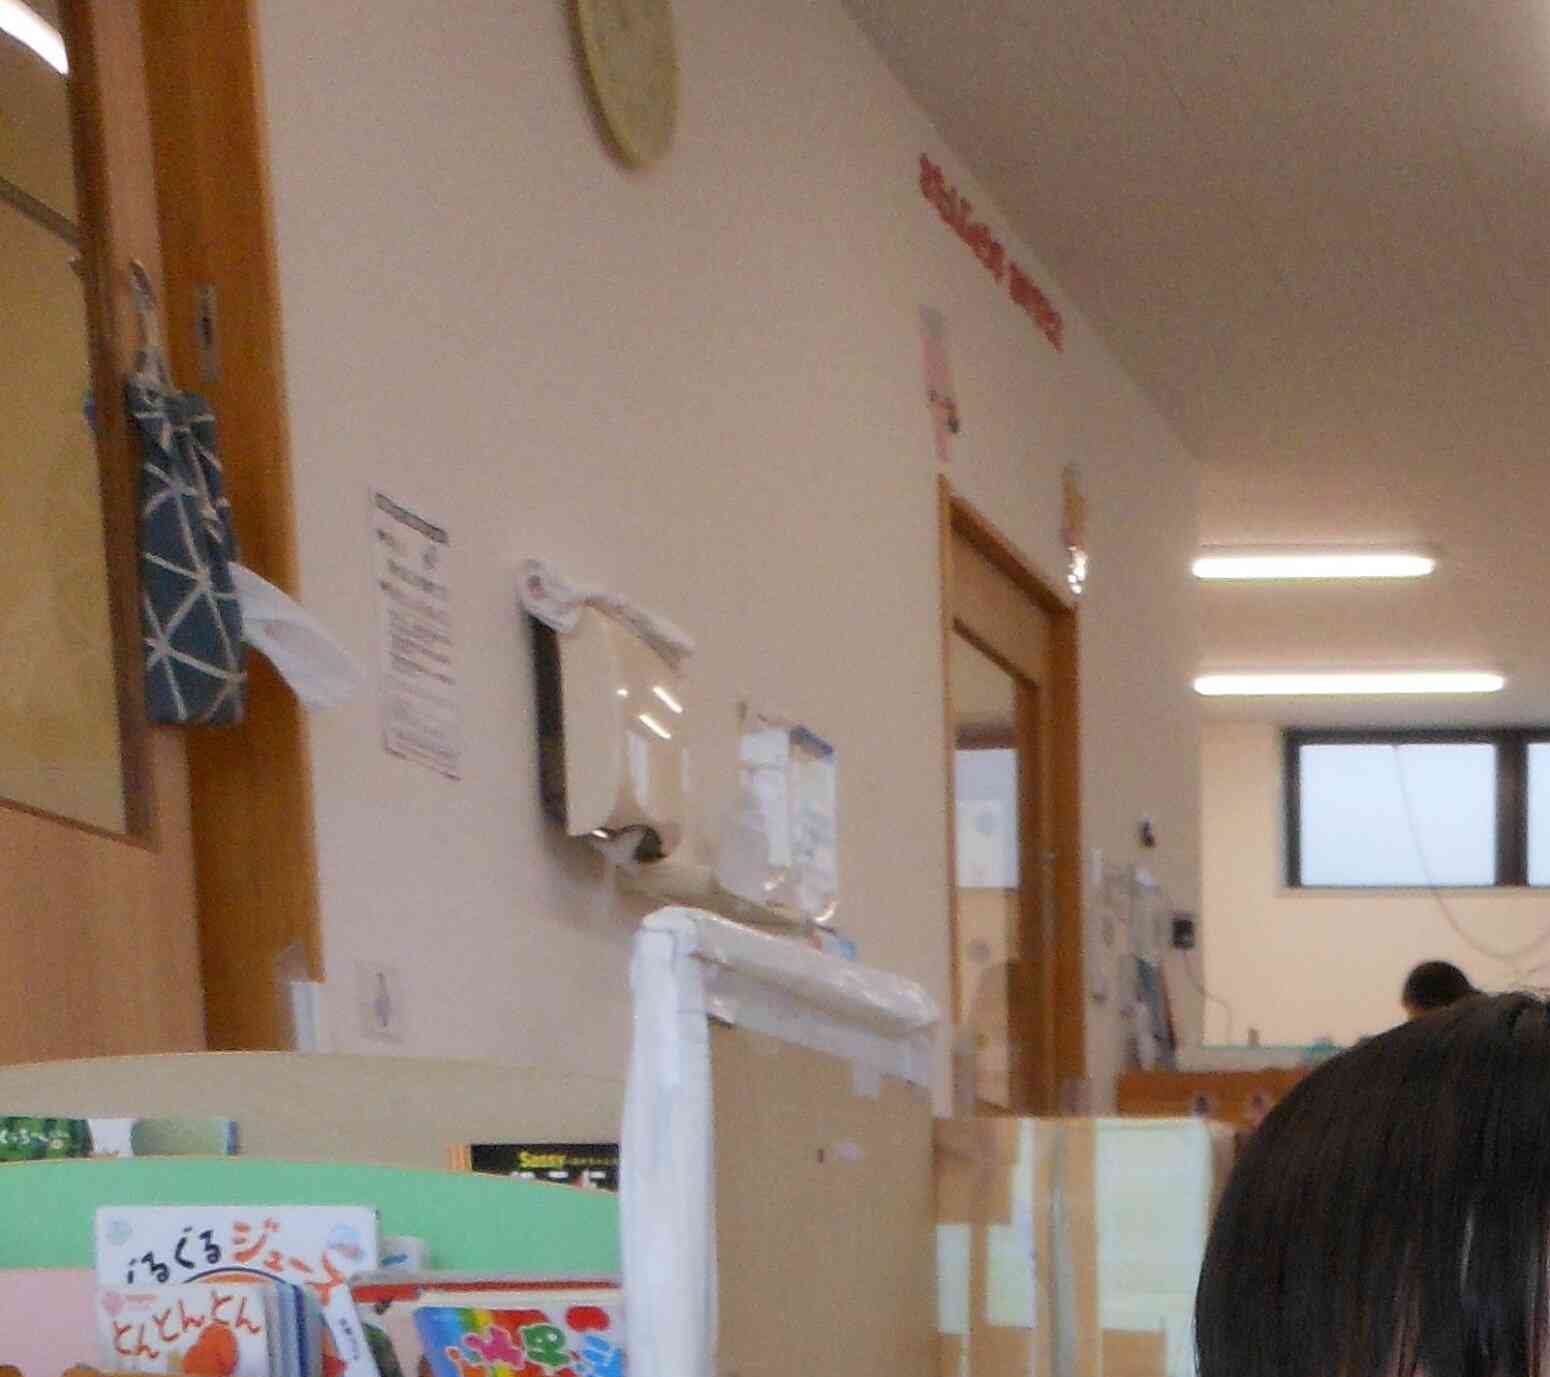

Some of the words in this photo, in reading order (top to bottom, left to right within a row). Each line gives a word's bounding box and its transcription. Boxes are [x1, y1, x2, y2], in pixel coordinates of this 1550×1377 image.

[112, 1289, 262, 1359] とんとんとん
